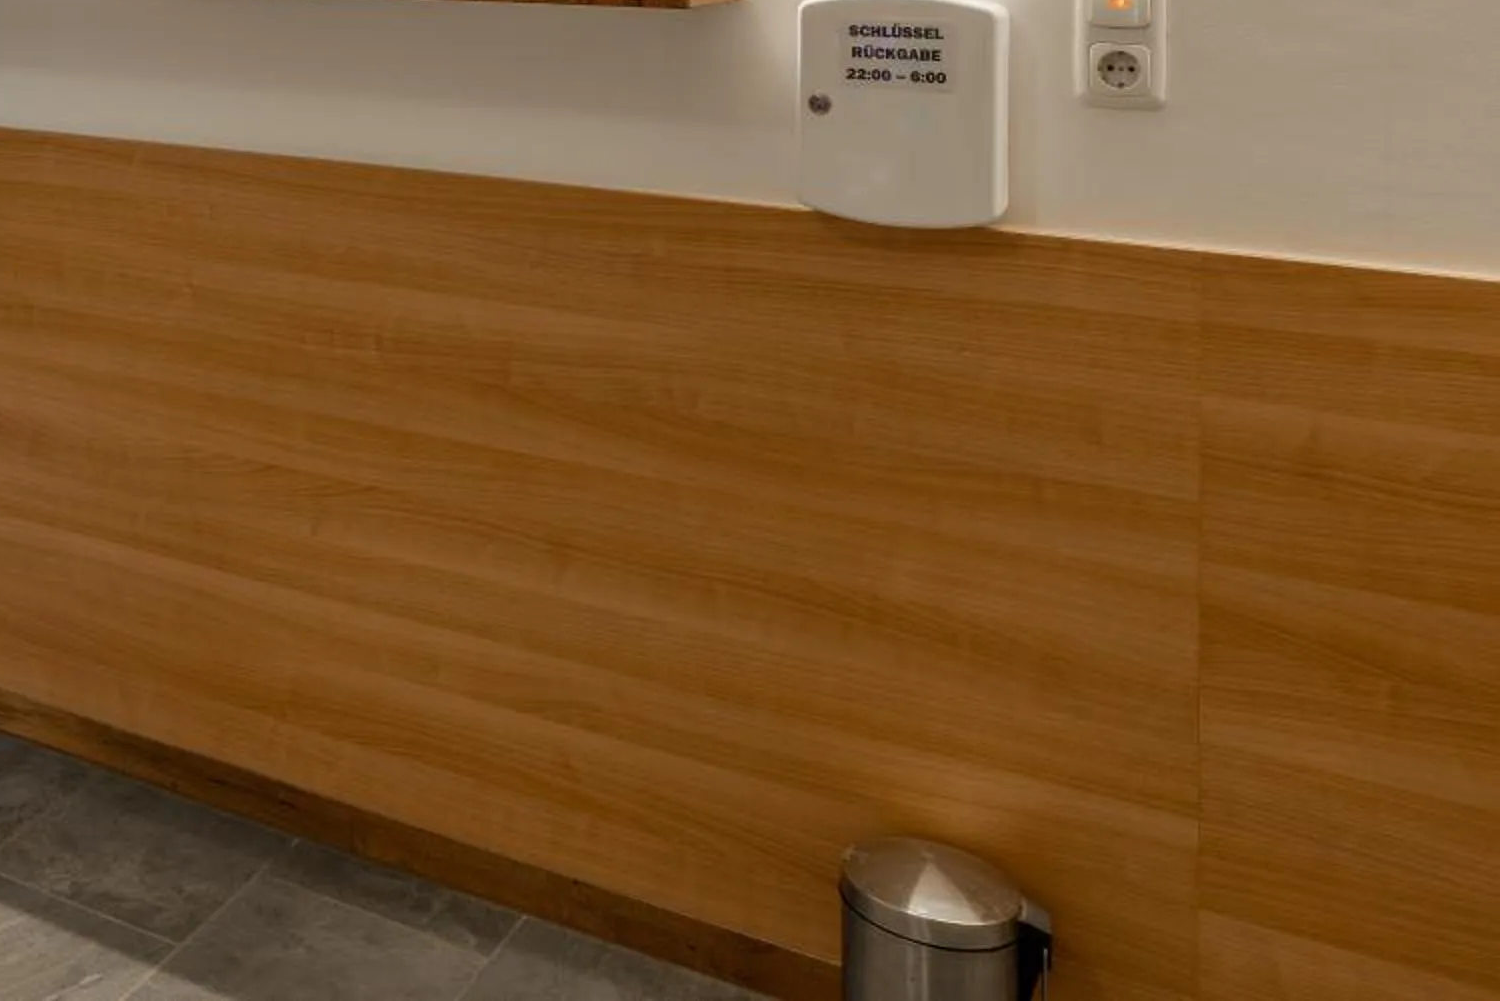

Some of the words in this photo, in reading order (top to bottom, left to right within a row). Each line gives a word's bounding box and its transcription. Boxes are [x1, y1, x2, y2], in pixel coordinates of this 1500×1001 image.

[848, 22, 944, 40] SCHLÜSSEL
[851, 44, 942, 62] RÜCKGABE
[845, 68, 892, 82] 22:00
[910, 70, 947, 84] 6:00
